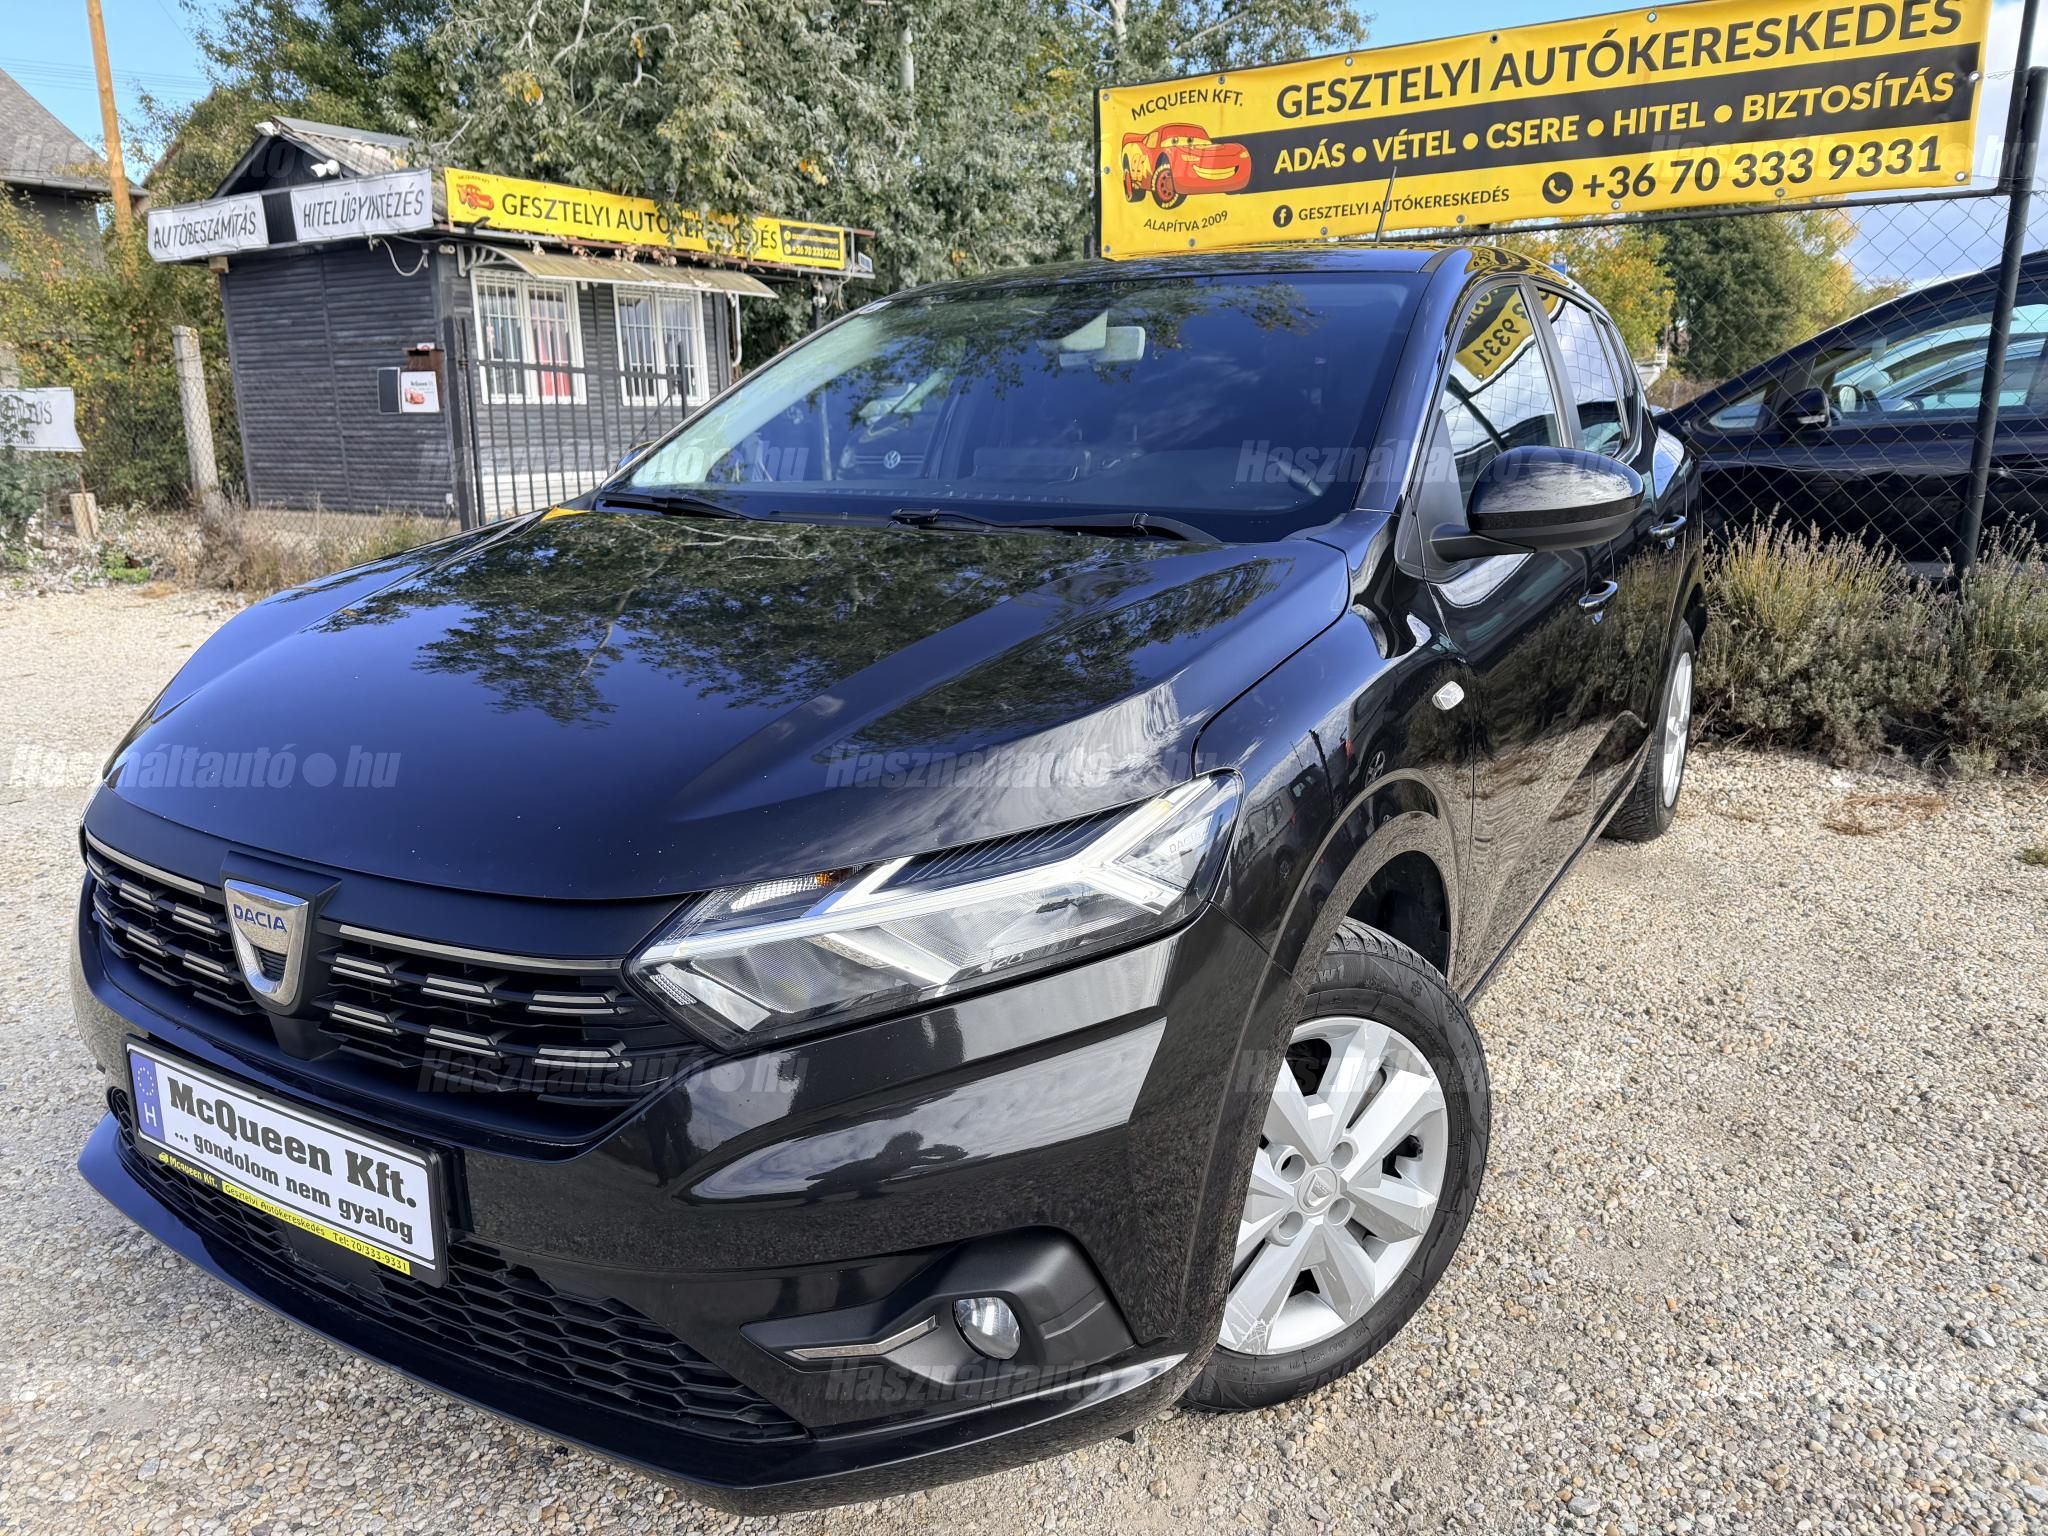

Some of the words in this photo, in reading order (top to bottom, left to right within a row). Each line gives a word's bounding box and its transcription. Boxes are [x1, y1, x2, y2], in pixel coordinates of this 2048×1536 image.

[1131, 88, 1209, 121] MCQUEEN
[1212, 88, 1243, 107] KFT.
[1276, 56, 1481, 119] GESZTELYI
[1273, 139, 1346, 175] ADÁS
[1372, 129, 1457, 163] VÉTEL
[1485, 115, 1581, 150] CSERE
[1613, 101, 1706, 138] HITEL
[1742, 66, 1955, 124] BIZTOSÍTÁS
[1583, 163, 1657, 200] +36
[1669, 156, 1721, 194] 70
[1732, 147, 1814, 188] 333
[1828, 135, 1942, 181] 9331
[303, 183, 425, 228] HITELÜGYINTÉZÉS
[502, 193, 611, 227] GESZTELYI
[1144, 218, 1200, 233] ALAPÍTVA
[1201, 210, 1228, 229] 2009
[1298, 202, 1369, 221] GESZTELYI
[1372, 188, 1510, 214] AUTÓKERESKEDÉS
[153, 204, 257, 249] AUTÓBESZÁMÍTÁS
[233, 903, 288, 933] DACIA
[144, 1102, 157, 1128] H
[168, 1076, 333, 1176] McQueen
[345, 1149, 417, 1209] Kft.
[169, 1156, 202, 1180] Mcqueen
[202, 1173, 218, 1188] Kft.
[193, 1133, 279, 1187] gondolom
[285, 1176, 331, 1208] nem
[338, 1198, 413, 1245] gyalog
